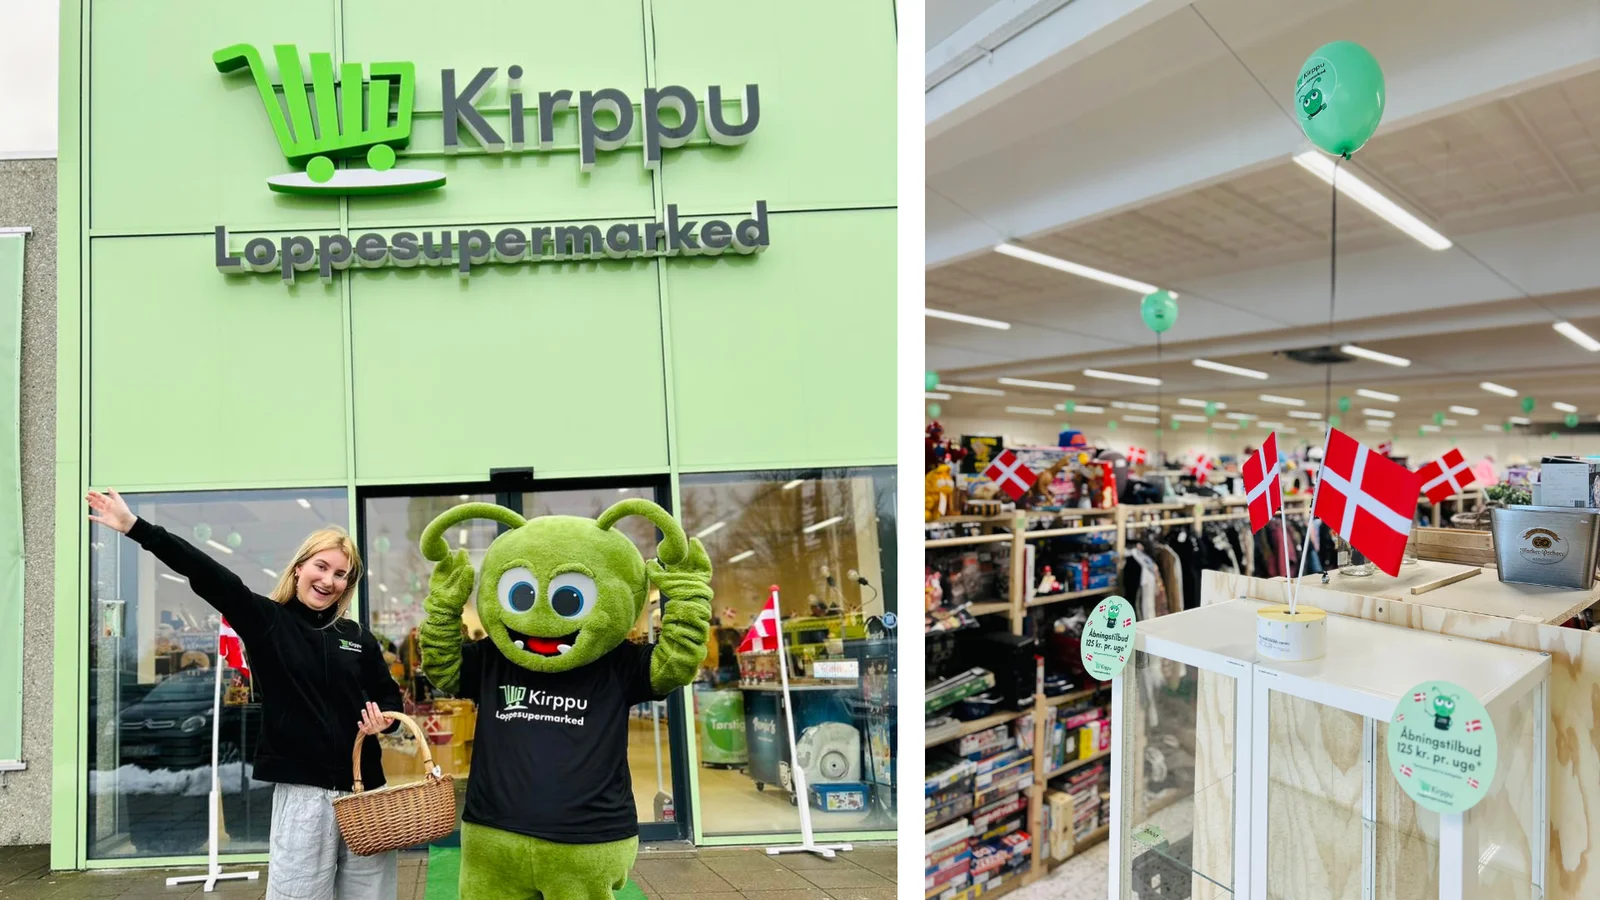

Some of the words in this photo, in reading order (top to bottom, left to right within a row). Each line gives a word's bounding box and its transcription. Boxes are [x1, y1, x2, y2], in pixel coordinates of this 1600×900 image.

[1303, 63, 1325, 79] Kirppu
[441, 65, 761, 171] Kirppu
[214, 200, 770, 286] Loppesupermarked
[1089, 628, 1129, 642] Åbningstilbud
[529, 690, 588, 711] Kirppu
[495, 711, 584, 726] Loppesupermarked
[1400, 725, 1481, 757] Åbningstilbud
[1397, 742, 1413, 755] 125
[1416, 745, 1430, 760] kr.
[1433, 753, 1449, 765] pr.
